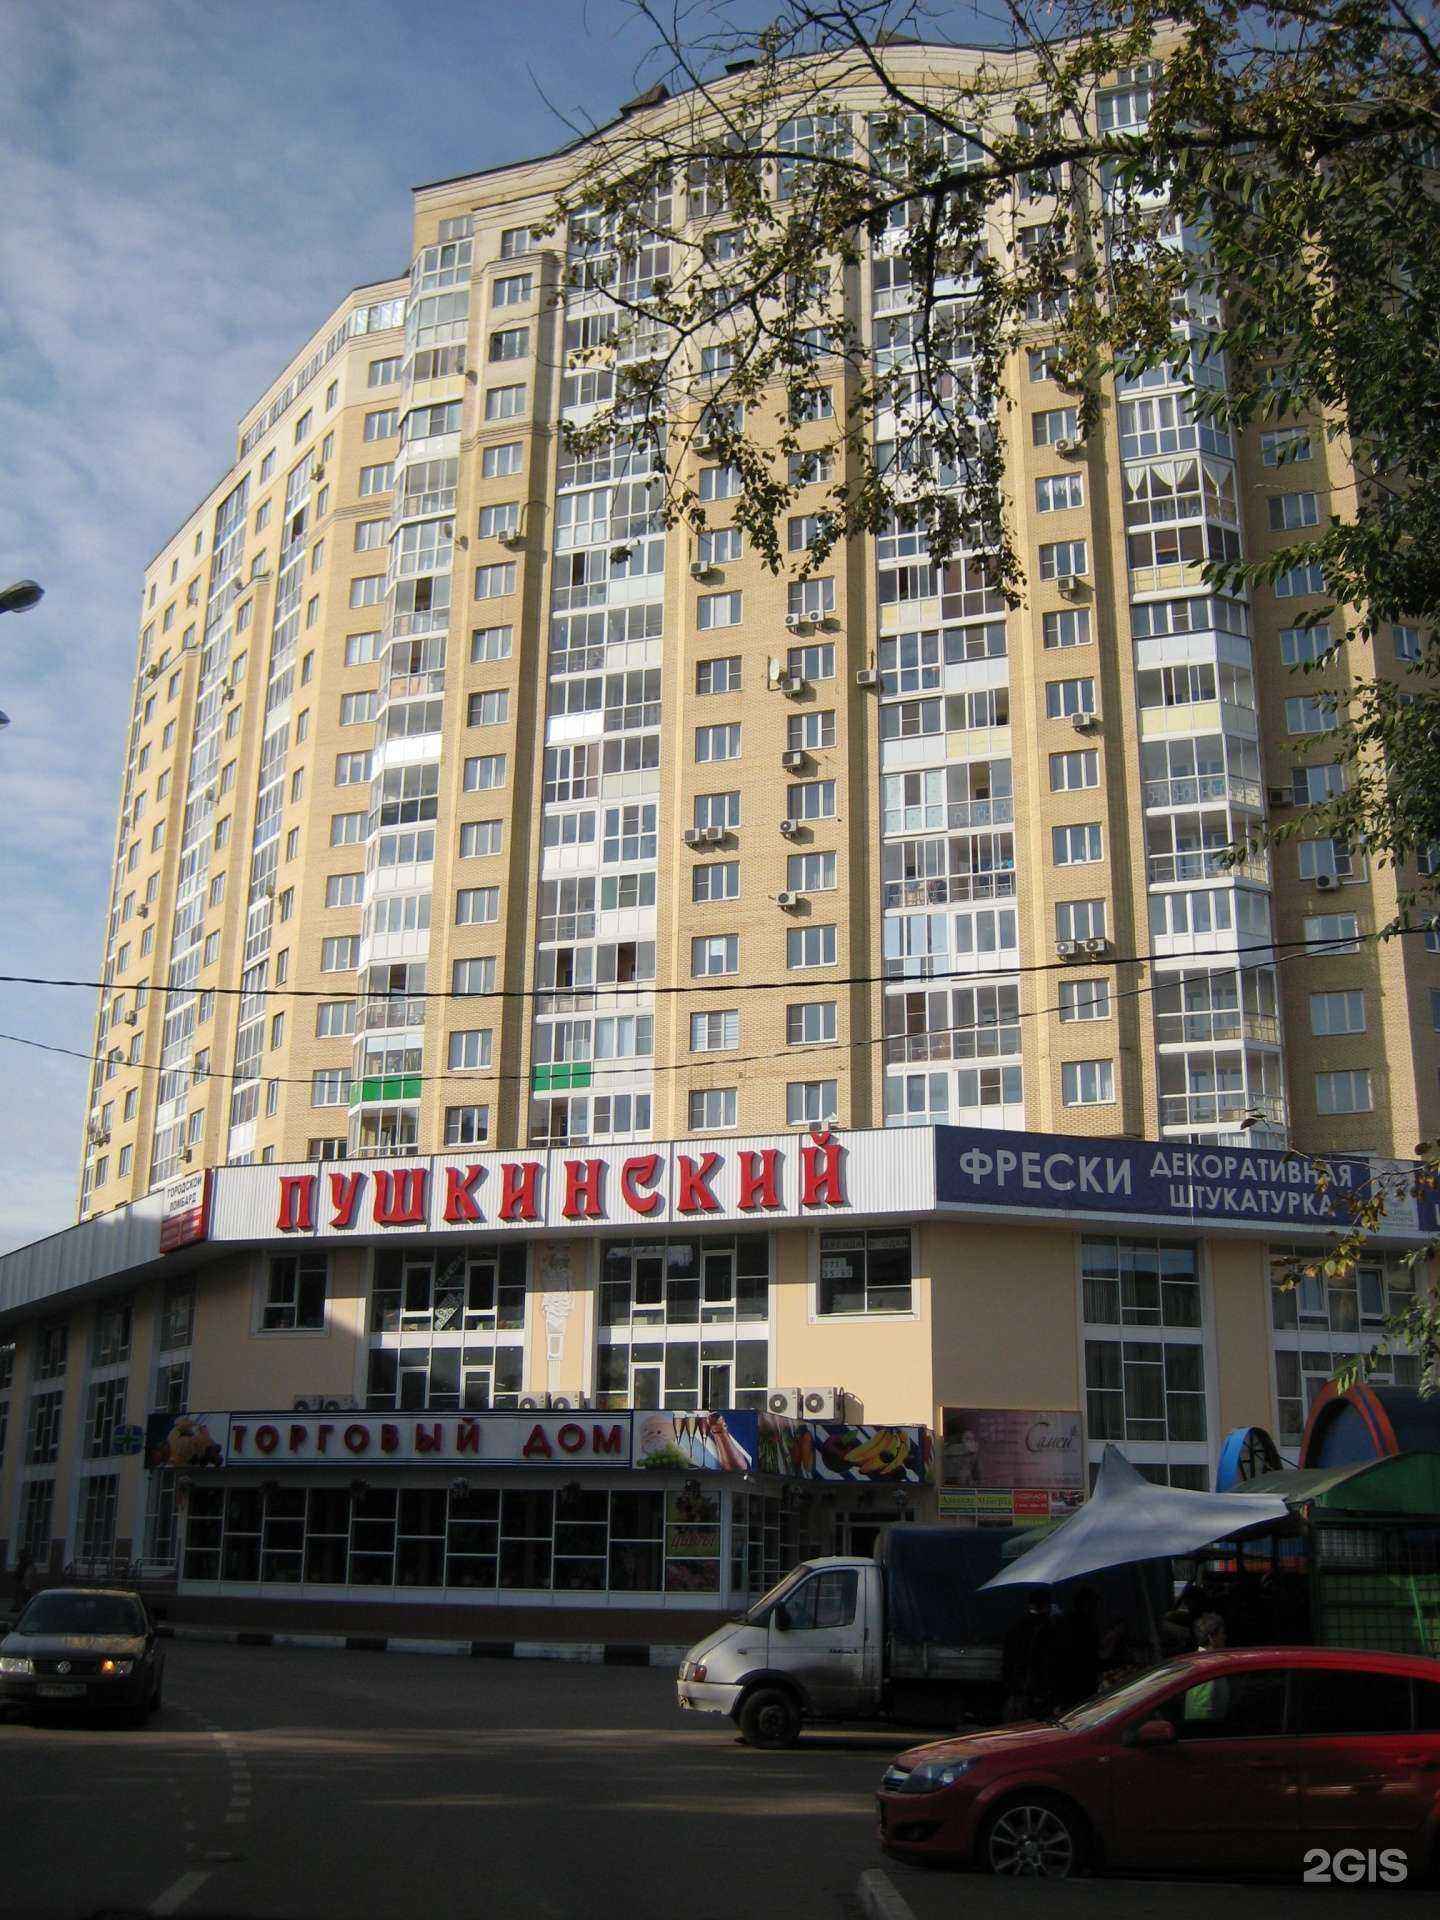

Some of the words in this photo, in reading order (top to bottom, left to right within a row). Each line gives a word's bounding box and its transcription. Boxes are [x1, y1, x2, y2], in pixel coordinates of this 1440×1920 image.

[277, 1130, 849, 1232] ПУШКИНСКИЙ
[959, 1147, 1133, 1196] ФРЕСКИ
[1150, 1151, 1353, 1188] ДЕКОРАТИВНАЯ
[1169, 1184, 1337, 1218] ШТУКАТУРКА
[231, 1416, 483, 1456] ТОРГОВЫЙ
[522, 1422, 625, 1459] ДОМ
